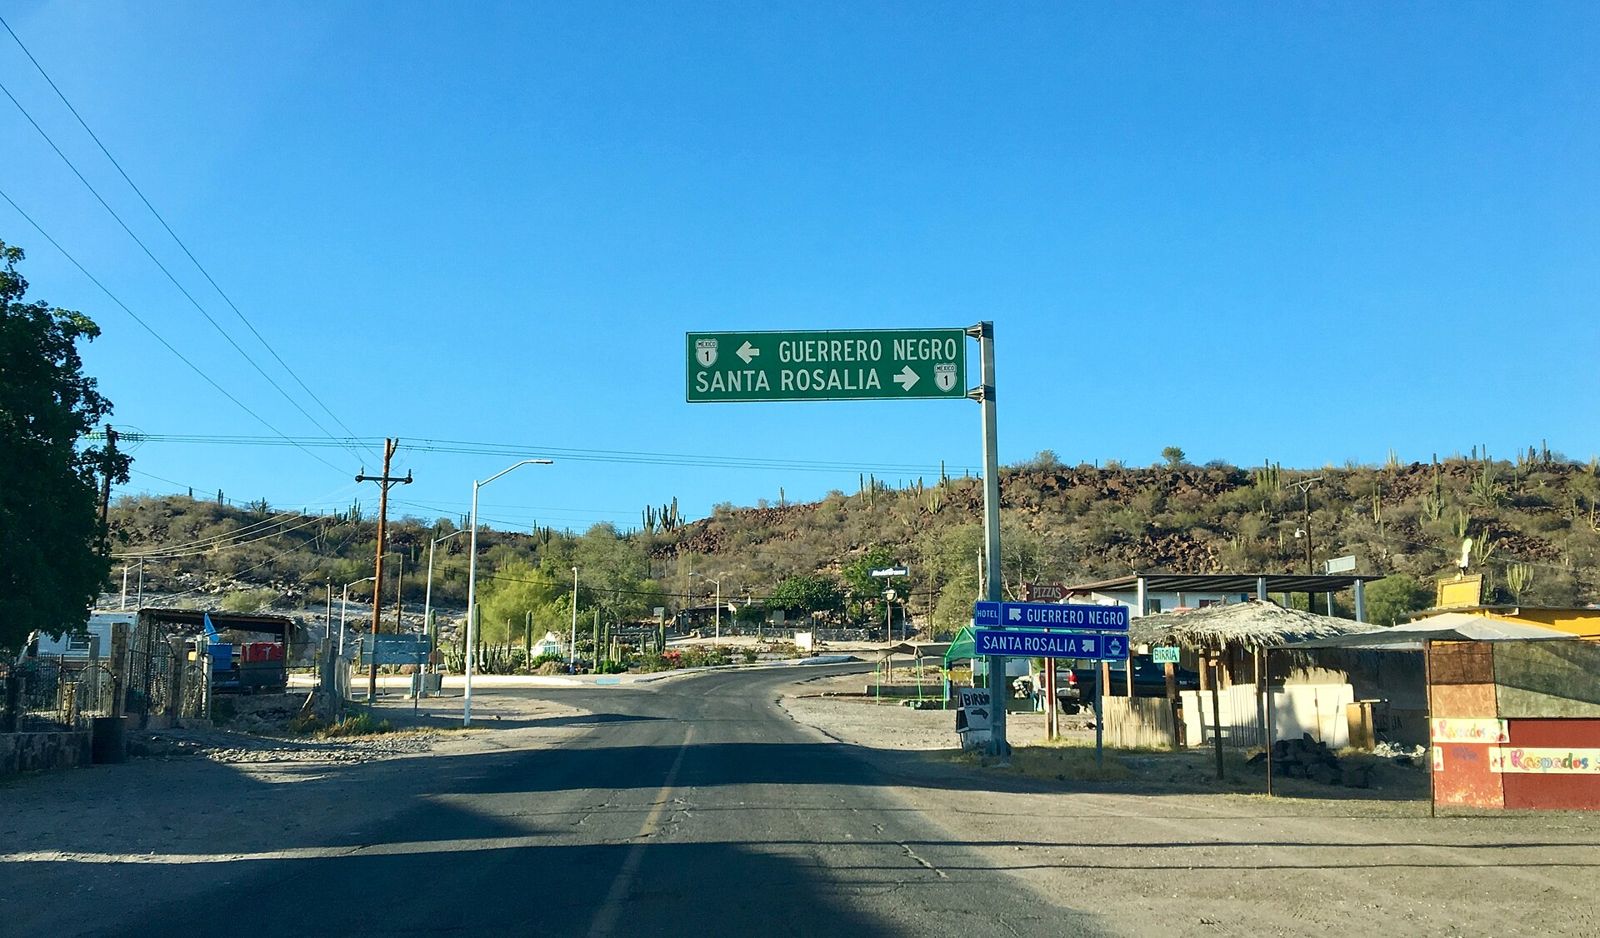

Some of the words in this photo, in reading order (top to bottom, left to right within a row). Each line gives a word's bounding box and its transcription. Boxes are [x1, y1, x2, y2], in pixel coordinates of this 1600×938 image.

[705, 351, 709, 361] 1
[779, 339, 882, 362] GUERRERO
[893, 338, 957, 361] NEGRO
[695, 369, 771, 392] SANTA
[781, 368, 881, 391] ROSALIA
[944, 375, 948, 386] 1
[1033, 586, 1061, 598] PIZZAS
[977, 609, 998, 618] HOTEL
[1027, 608, 1084, 624] GUERRERO
[1088, 611, 1124, 625] NEGRO
[983, 635, 1022, 650] SANTA
[1025, 637, 1077, 652] ROSALIA
[1154, 649, 1177, 660] BIRRIA
[1510, 749, 1589, 771] Raspados
